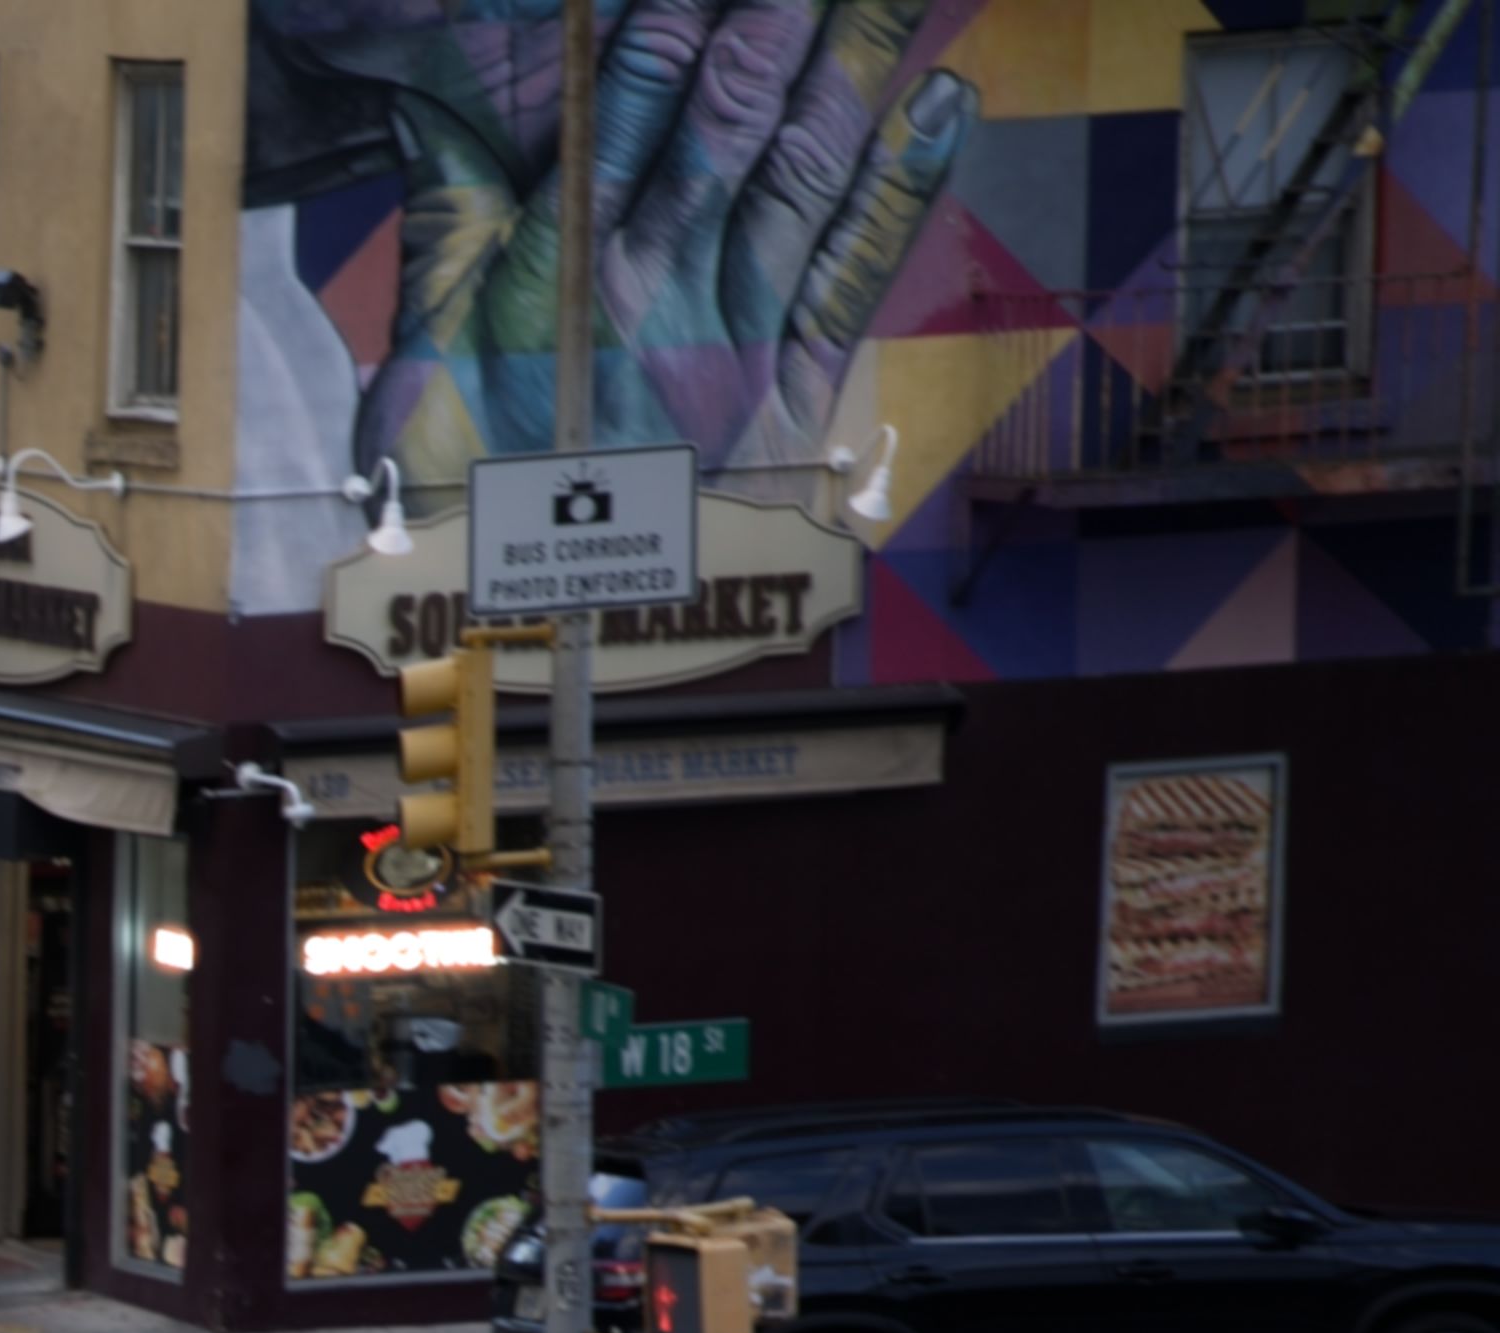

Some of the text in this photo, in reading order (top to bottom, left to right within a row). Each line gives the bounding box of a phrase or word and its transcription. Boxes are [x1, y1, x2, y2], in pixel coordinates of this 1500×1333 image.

[504, 533, 662, 566] BUS CORRIDOR
[490, 568, 677, 599] PHOTO ENFORCED
[681, 747, 797, 779] MARKET
[621, 1034, 646, 1078] W
[658, 1031, 693, 1076] 18
